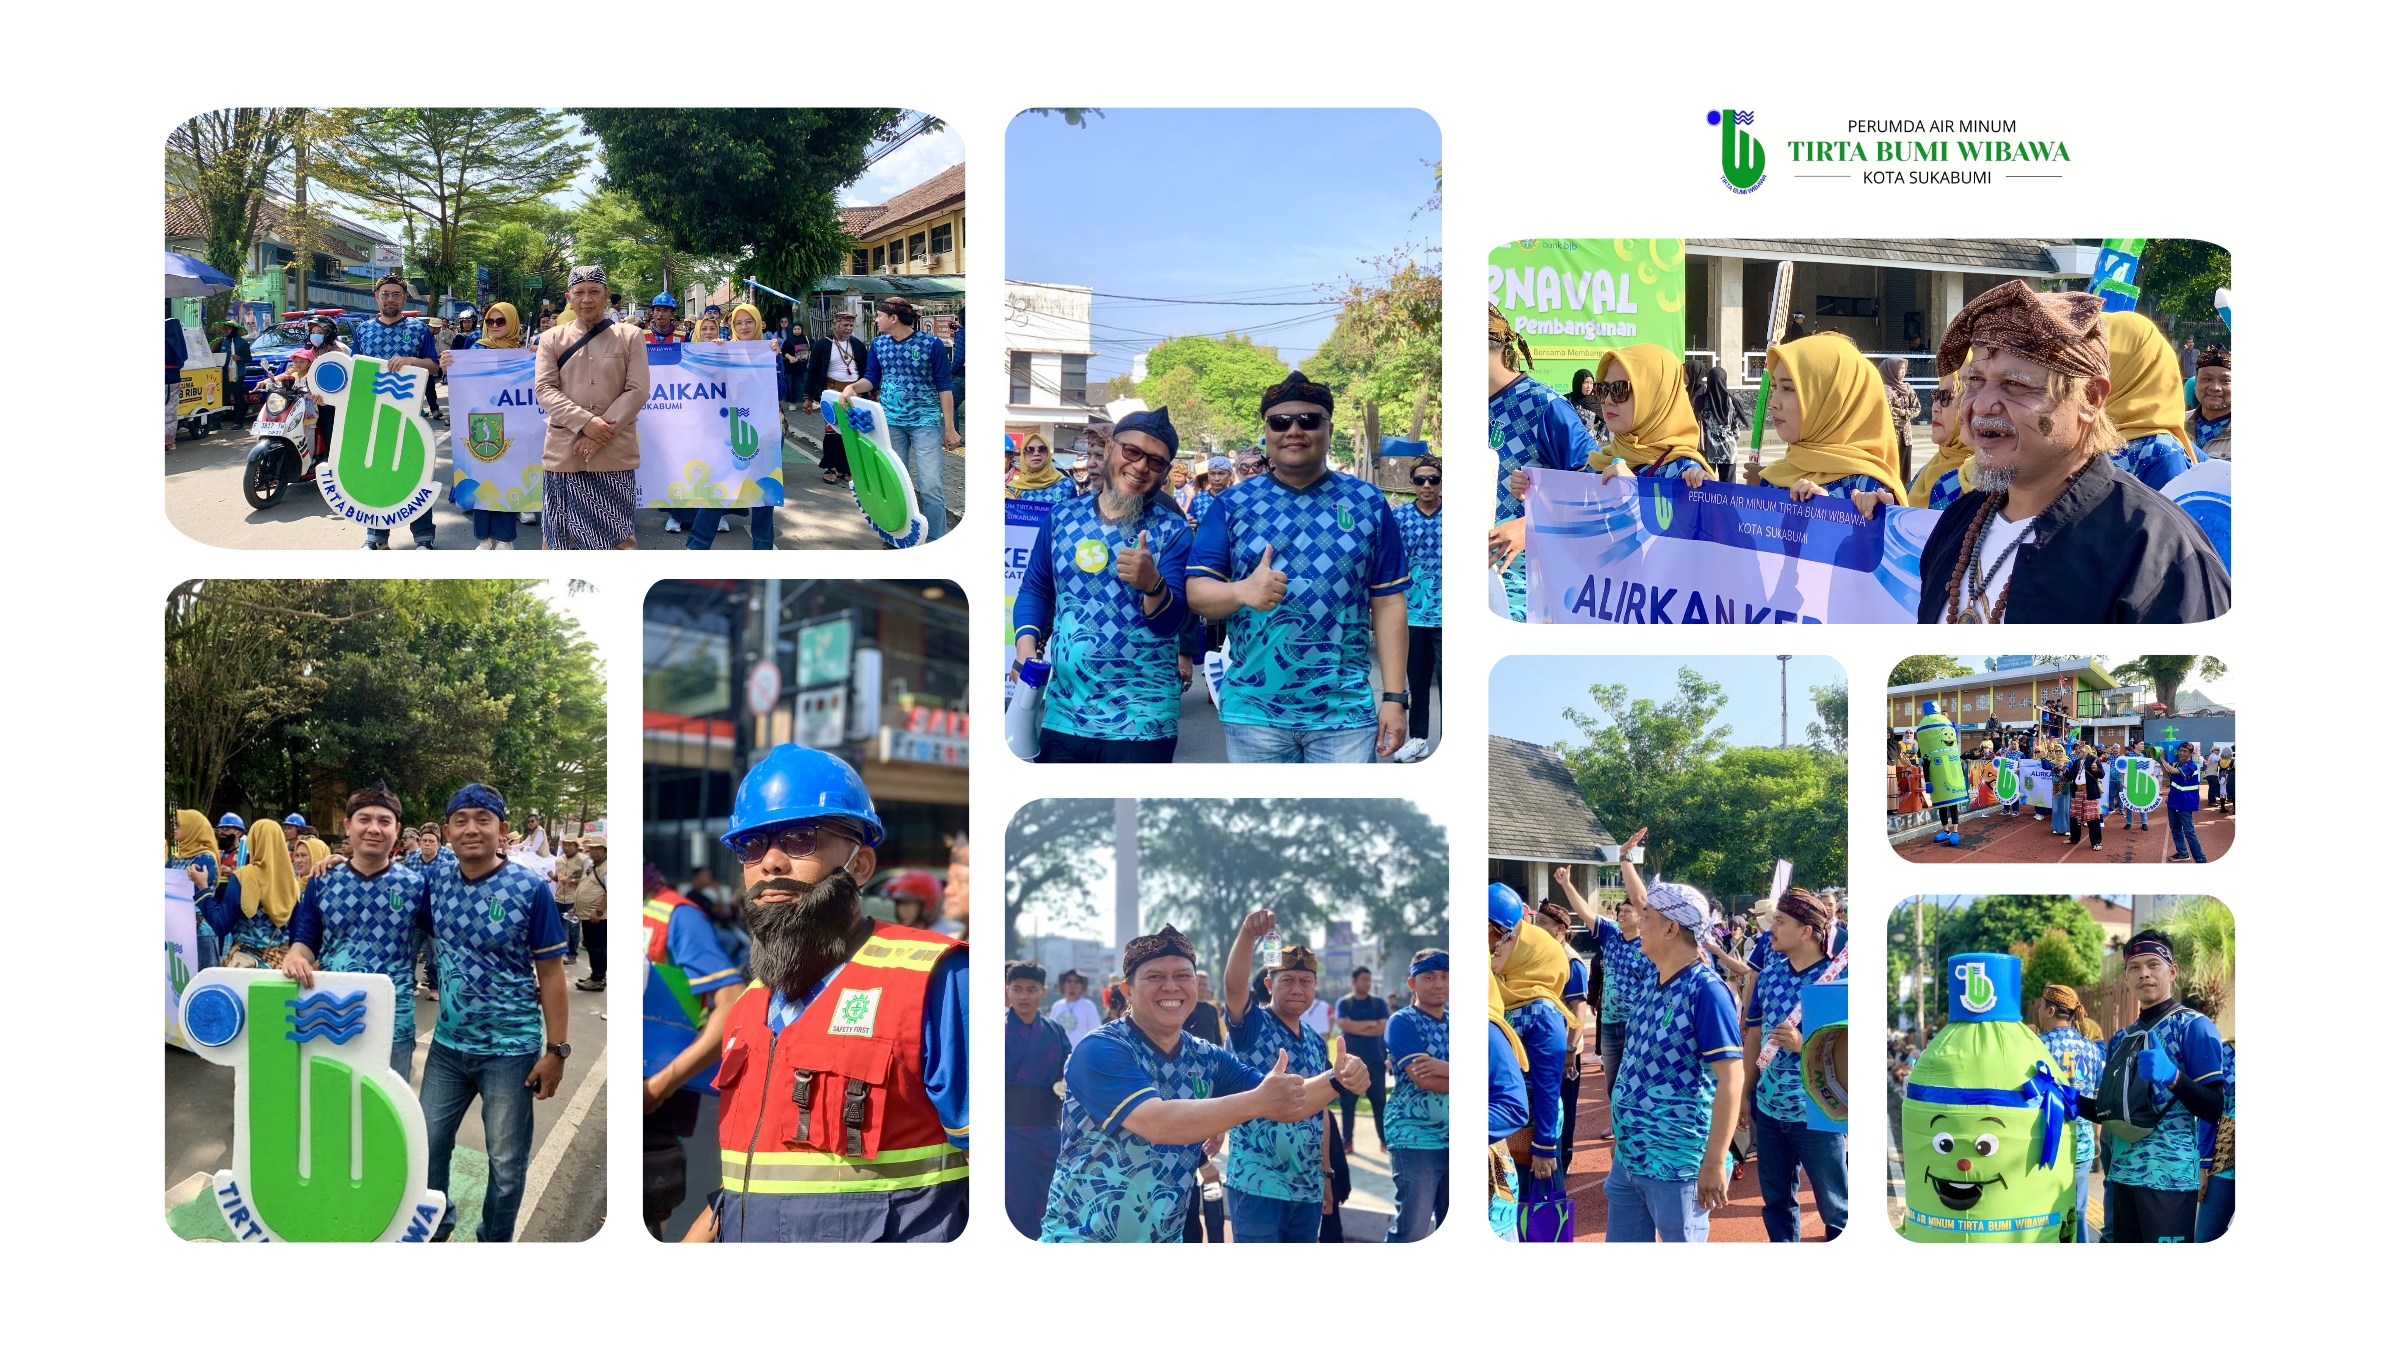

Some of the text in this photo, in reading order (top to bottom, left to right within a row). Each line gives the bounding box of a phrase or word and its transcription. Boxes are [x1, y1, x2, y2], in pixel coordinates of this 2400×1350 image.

[1542, 240, 1578, 251] bank bjb
[1514, 316, 1637, 341] Pembangunan
[1533, 349, 1566, 357] Bersama
[184, 387, 203, 397] RIBU
[497, 382, 727, 406] ALI AIKAN
[321, 469, 433, 527] TIRTA BUMI WIBAWA
[1006, 513, 1039, 521] SUKABUMI
[1688, 490, 1867, 527] PERUMDA AIR MINUM TIRTA BUMI WIBAWA
[1738, 522, 1809, 545] KOTA SUKABUMI
[832, 1025, 870, 1034] SAFETY FIRST
[218, 1181, 438, 1242] TIRT WA
[1928, 1216, 1955, 1230] MINUM
[1957, 1219, 1985, 1232] TIRTA
[1987, 1220, 2012, 1232] BUMI
[2014, 1215, 2050, 1230] WIBAWA
